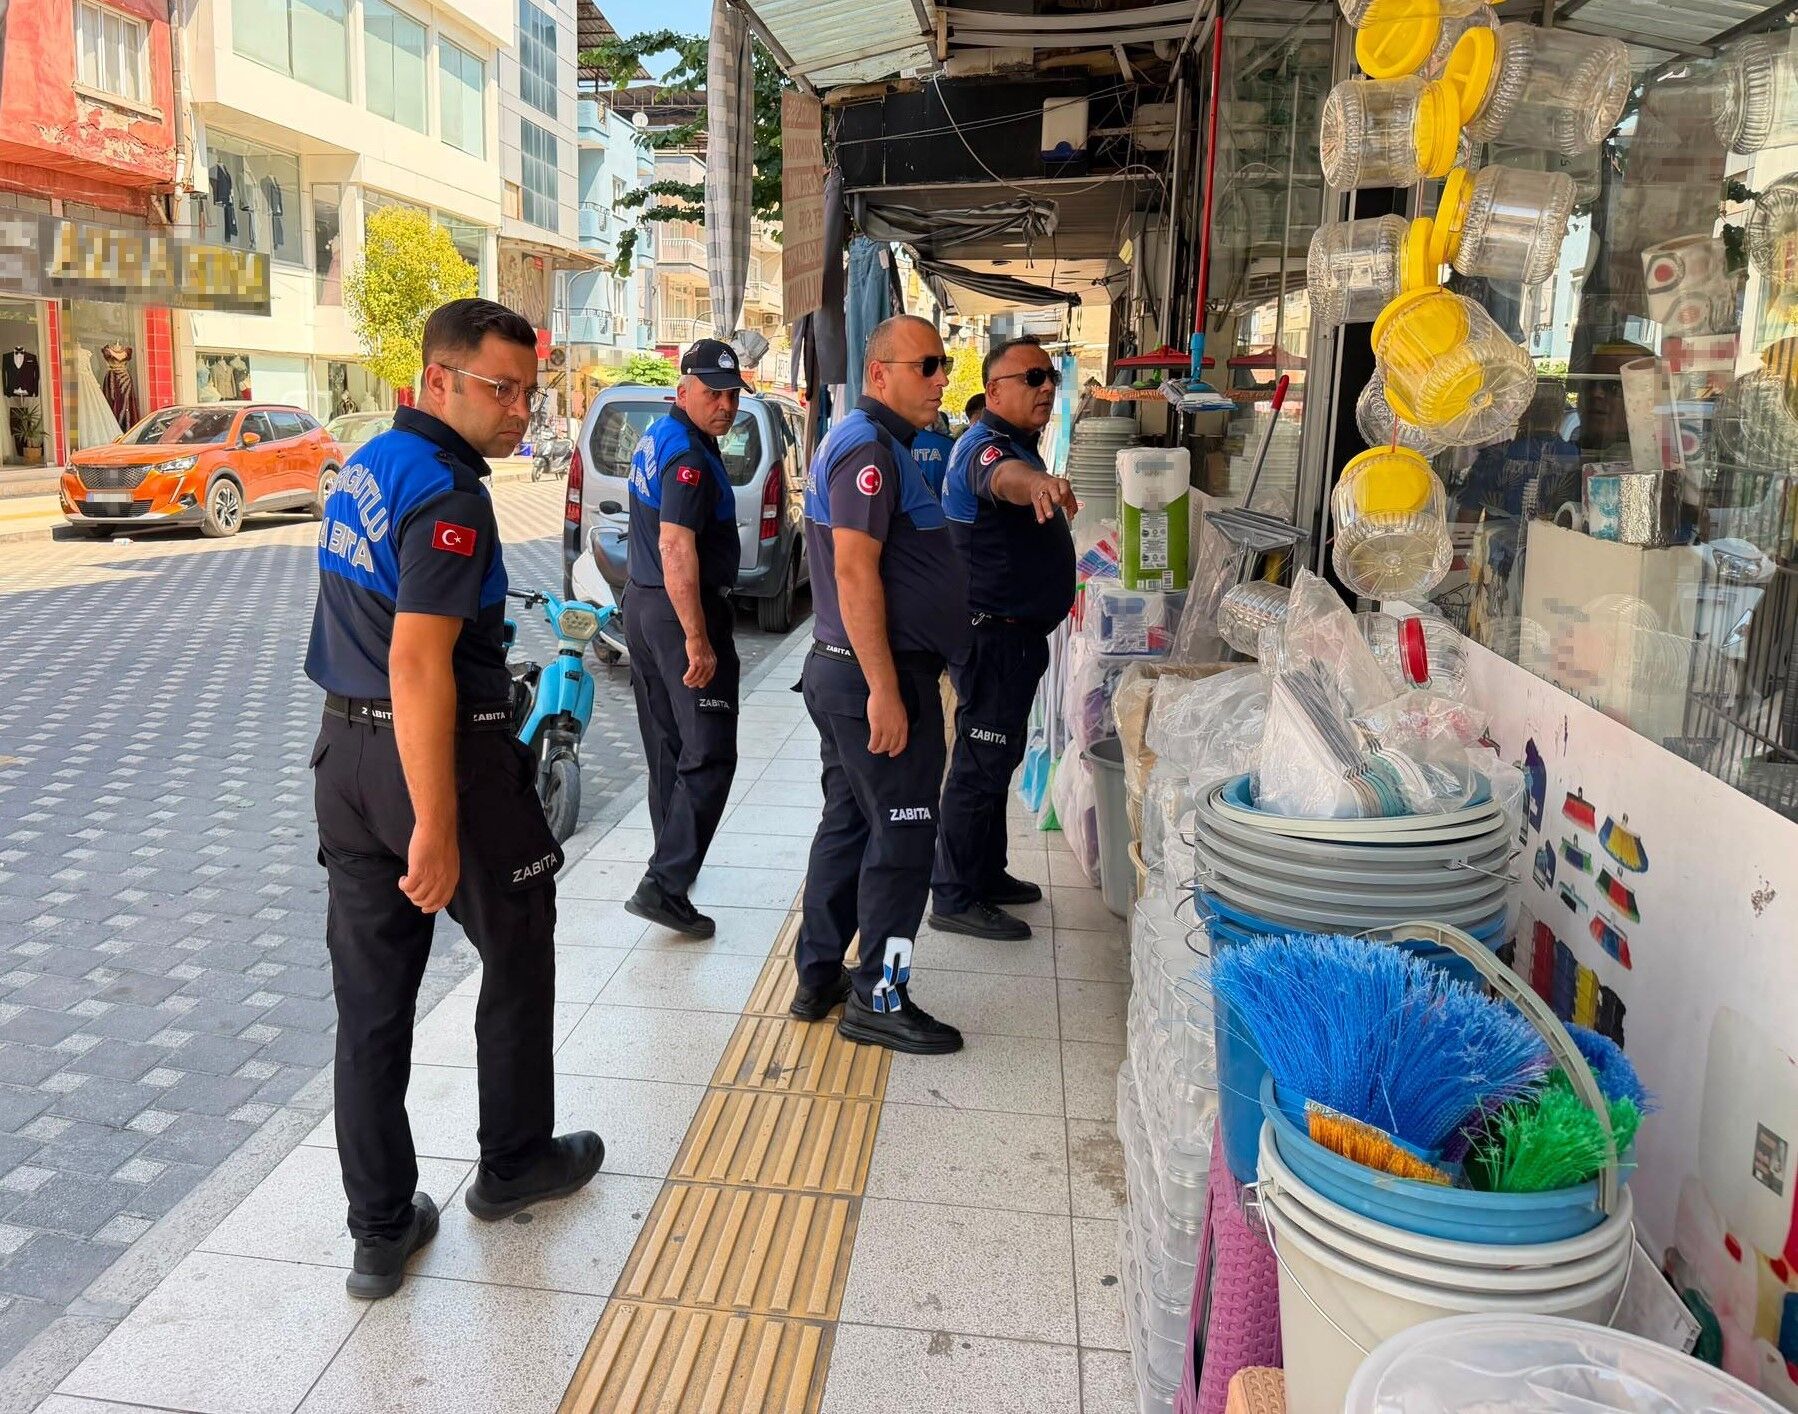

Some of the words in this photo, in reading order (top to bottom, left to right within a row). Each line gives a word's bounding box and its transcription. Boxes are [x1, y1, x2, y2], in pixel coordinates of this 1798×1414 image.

[826, 645, 851, 656] ZABITA
[699, 698, 730, 710] ZABITA
[970, 727, 1006, 745] ZABITA
[890, 806, 931, 821] ZABITA
[512, 851, 558, 883] ZABITA
